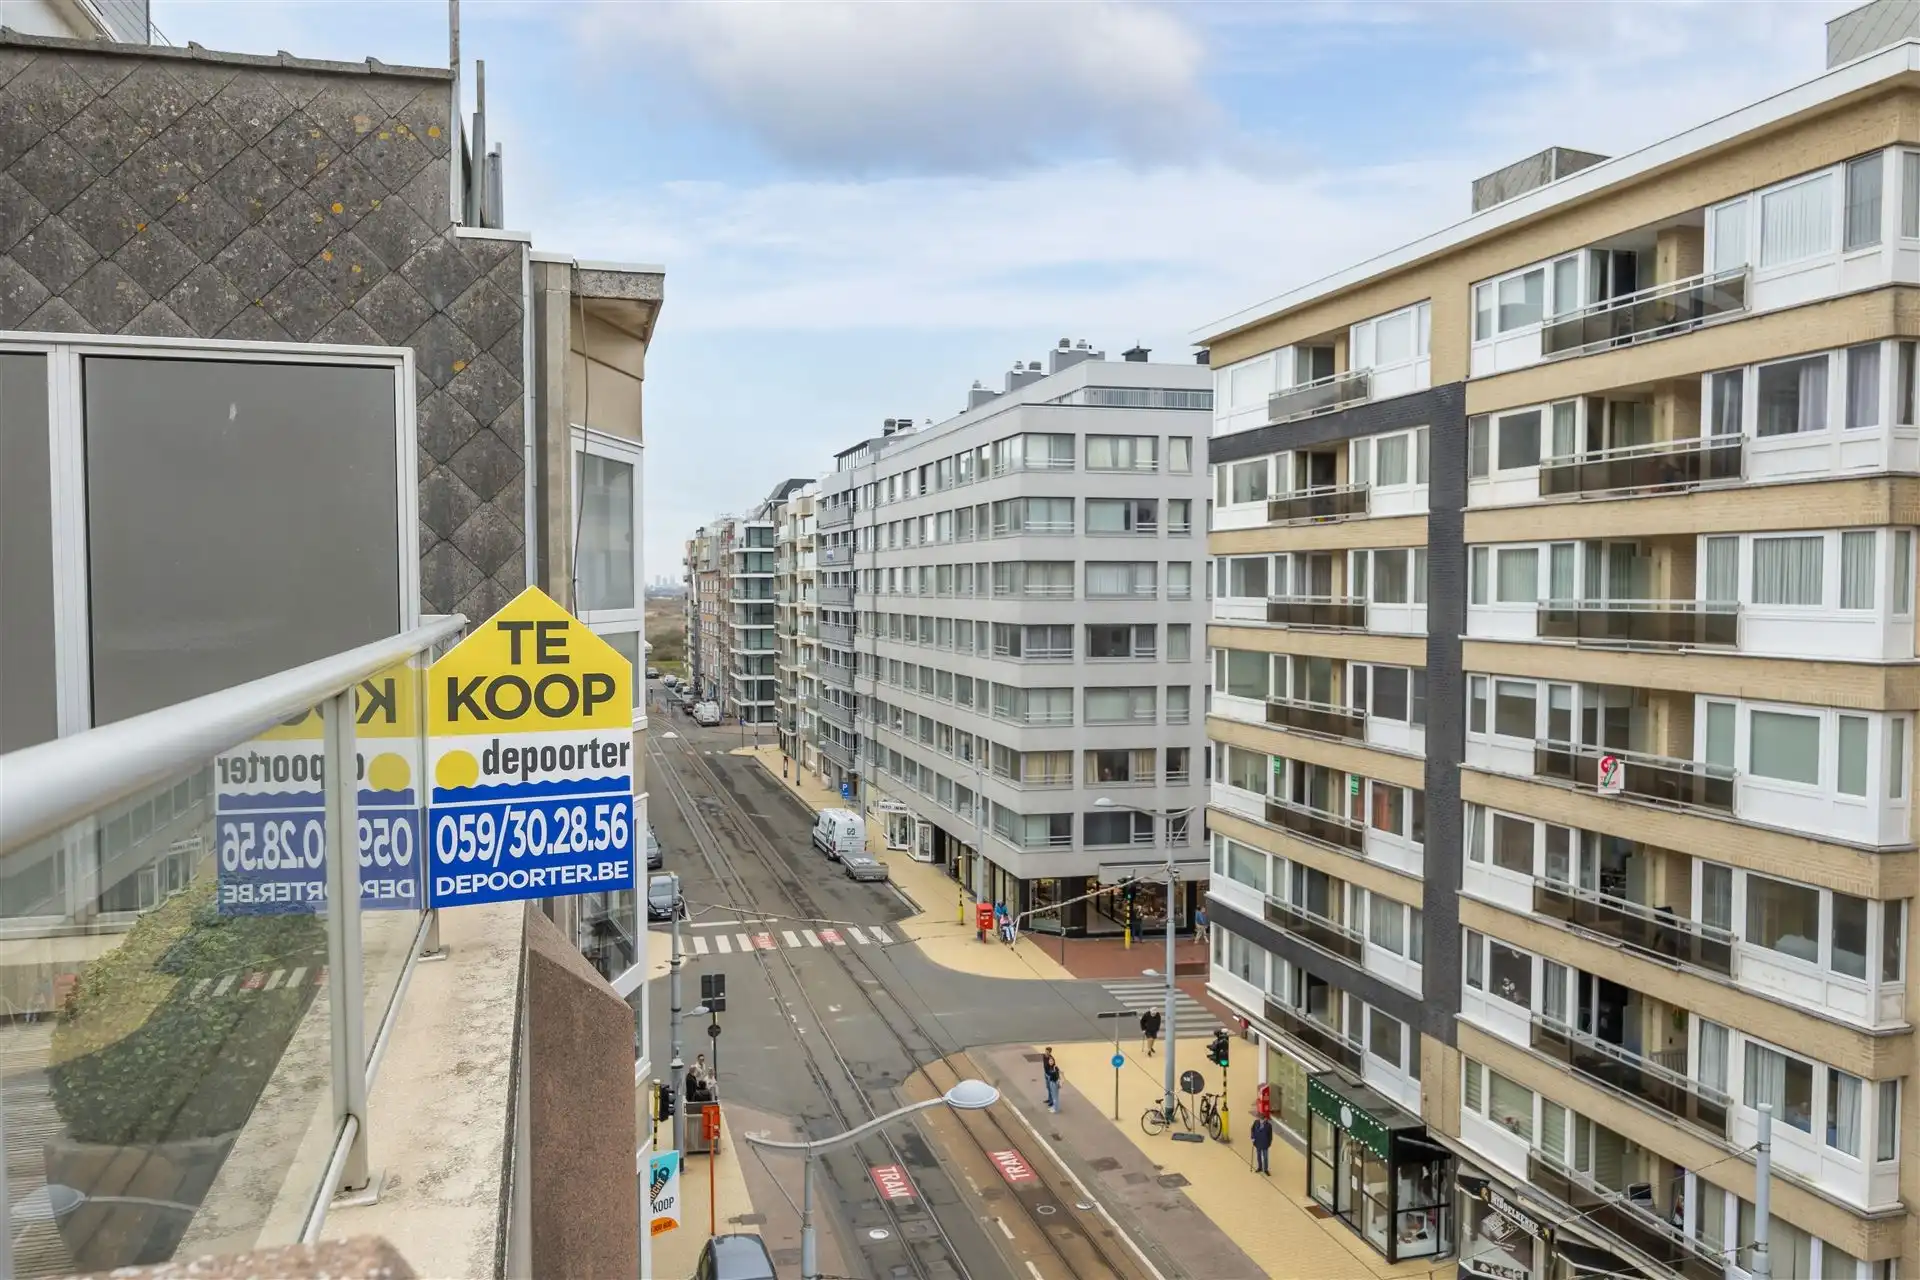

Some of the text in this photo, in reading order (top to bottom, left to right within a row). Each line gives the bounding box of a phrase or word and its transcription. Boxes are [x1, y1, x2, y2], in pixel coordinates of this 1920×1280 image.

[497, 621, 570, 665] TE
[447, 673, 616, 722] KOOP
[482, 737, 630, 782] depoorter
[436, 803, 629, 868] 059/30.28.56
[436, 860, 629, 896] DEPOORTER.BE
[877, 1166, 910, 1198] TRAM
[993, 1150, 1030, 1181] TRAM
[652, 1196, 675, 1214] KOOP
